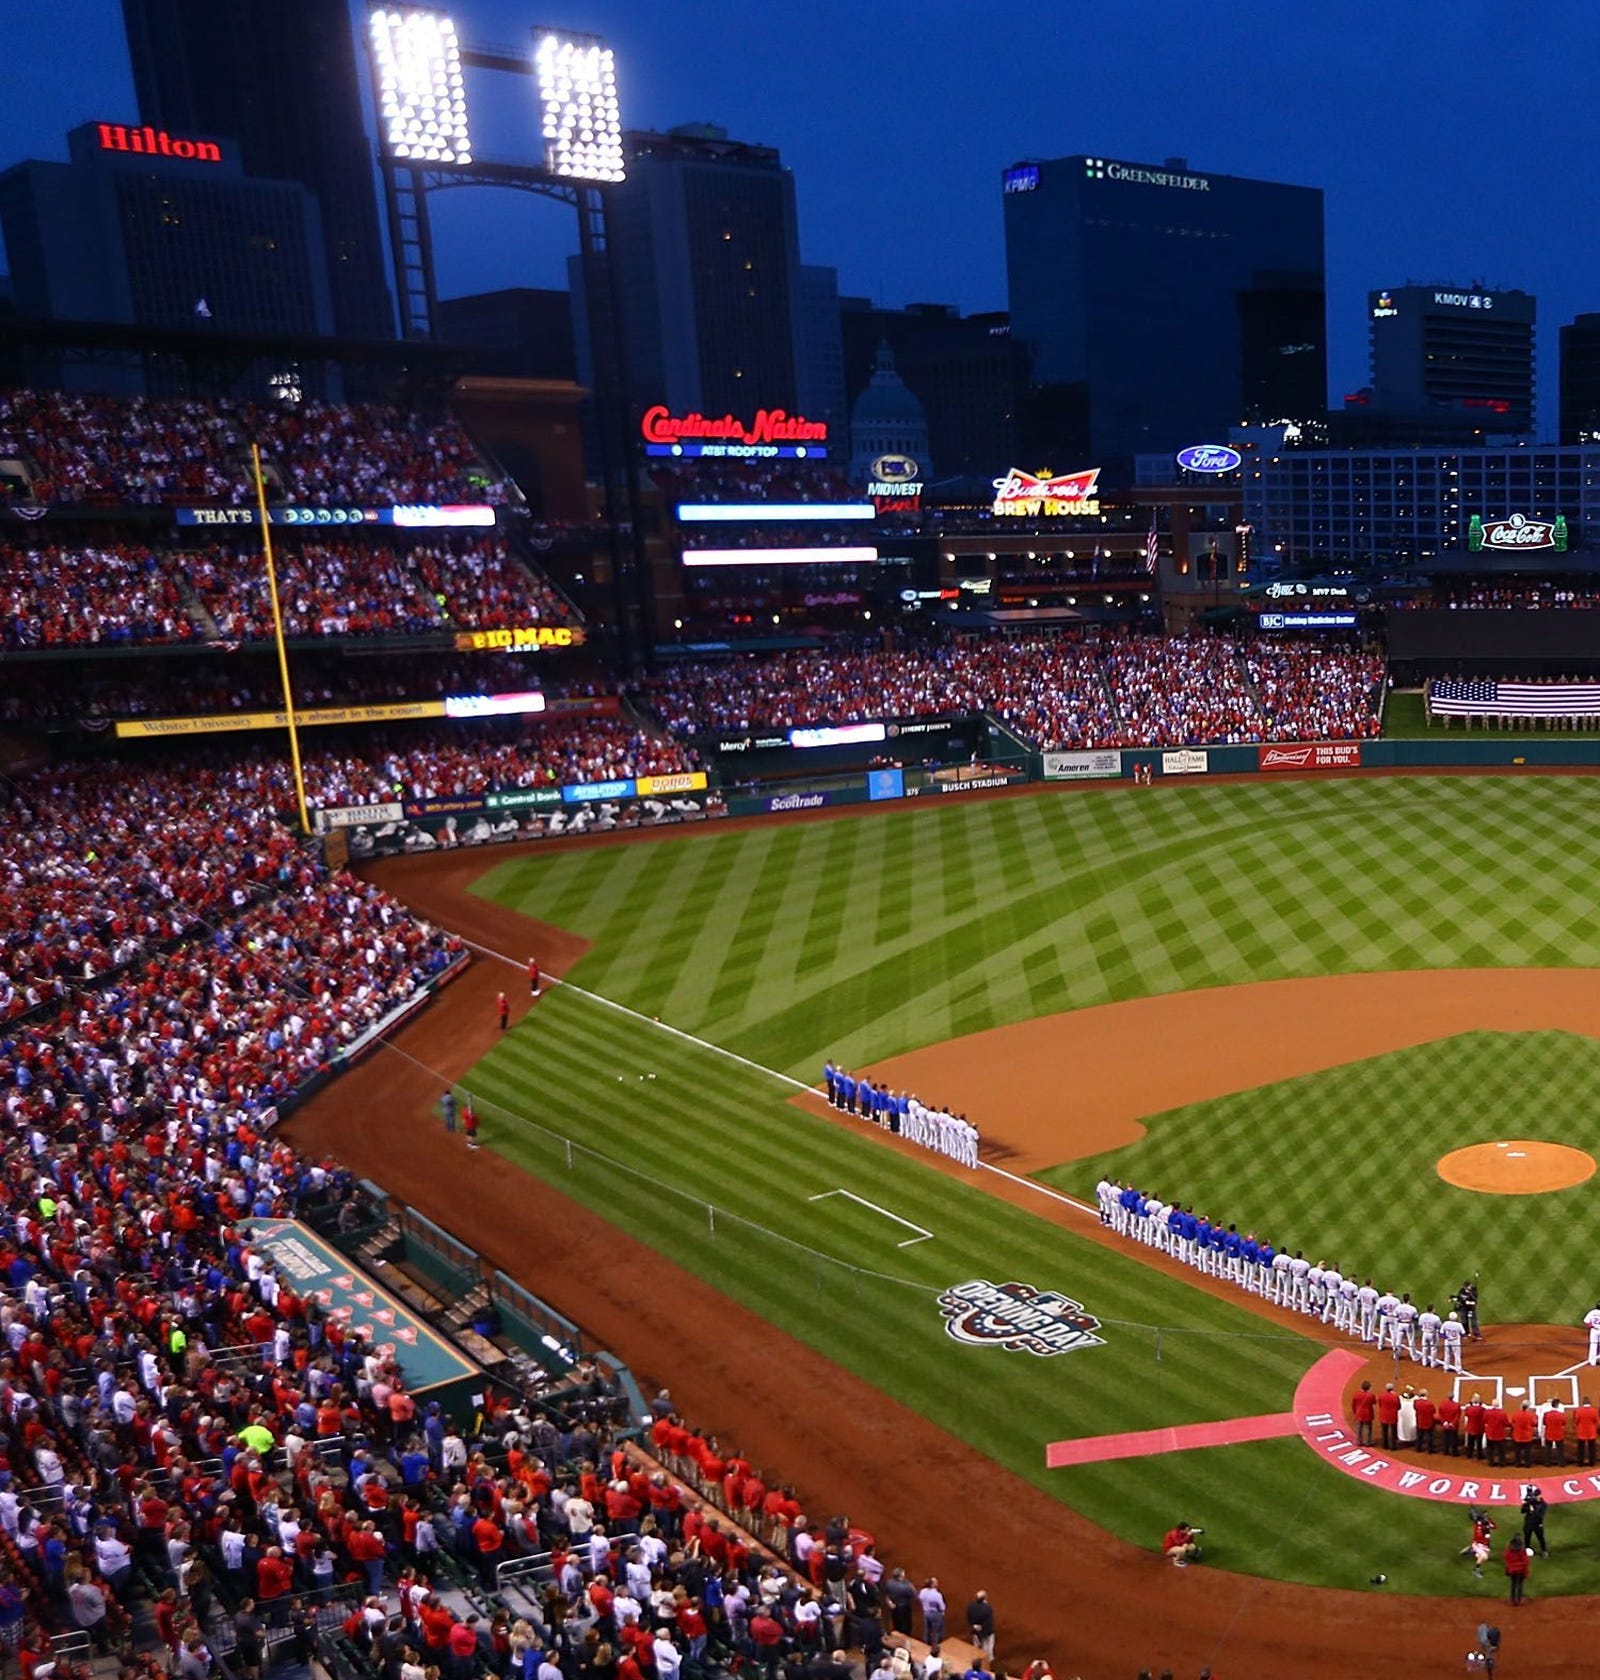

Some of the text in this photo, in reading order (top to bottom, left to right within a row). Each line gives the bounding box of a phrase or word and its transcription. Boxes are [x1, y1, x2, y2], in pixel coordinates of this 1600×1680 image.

[98, 124, 221, 161] Hilton
[1005, 176, 1036, 194] KPMG
[1434, 293, 1468, 307] KMOV
[642, 405, 827, 445] Cardinals Nation
[727, 446, 779, 457] ROOFTOP
[1191, 450, 1228, 469] Ford
[867, 482, 923, 496] MIDWEST
[994, 501, 1100, 516] BREW HOUSE
[193, 510, 252, 523] THAT'S
[1262, 616, 1282, 627] BJC
[512, 627, 573, 647] MAC
[366, 708, 385, 718] the
[720, 741, 746, 752] Mercy
[1315, 746, 1358, 755] THIS BUD'S
[1315, 756, 1332, 764] FOR
[1057, 763, 1090, 773] Ameren
[942, 776, 1008, 793] BUSCH STADIUM
[502, 794, 536, 805] Central
[537, 790, 562, 802] Bank
[771, 792, 824, 811] Scottrade
[952, 1281, 1101, 1351] OPENING DAY
[1316, 1429, 1390, 1477] TIME
